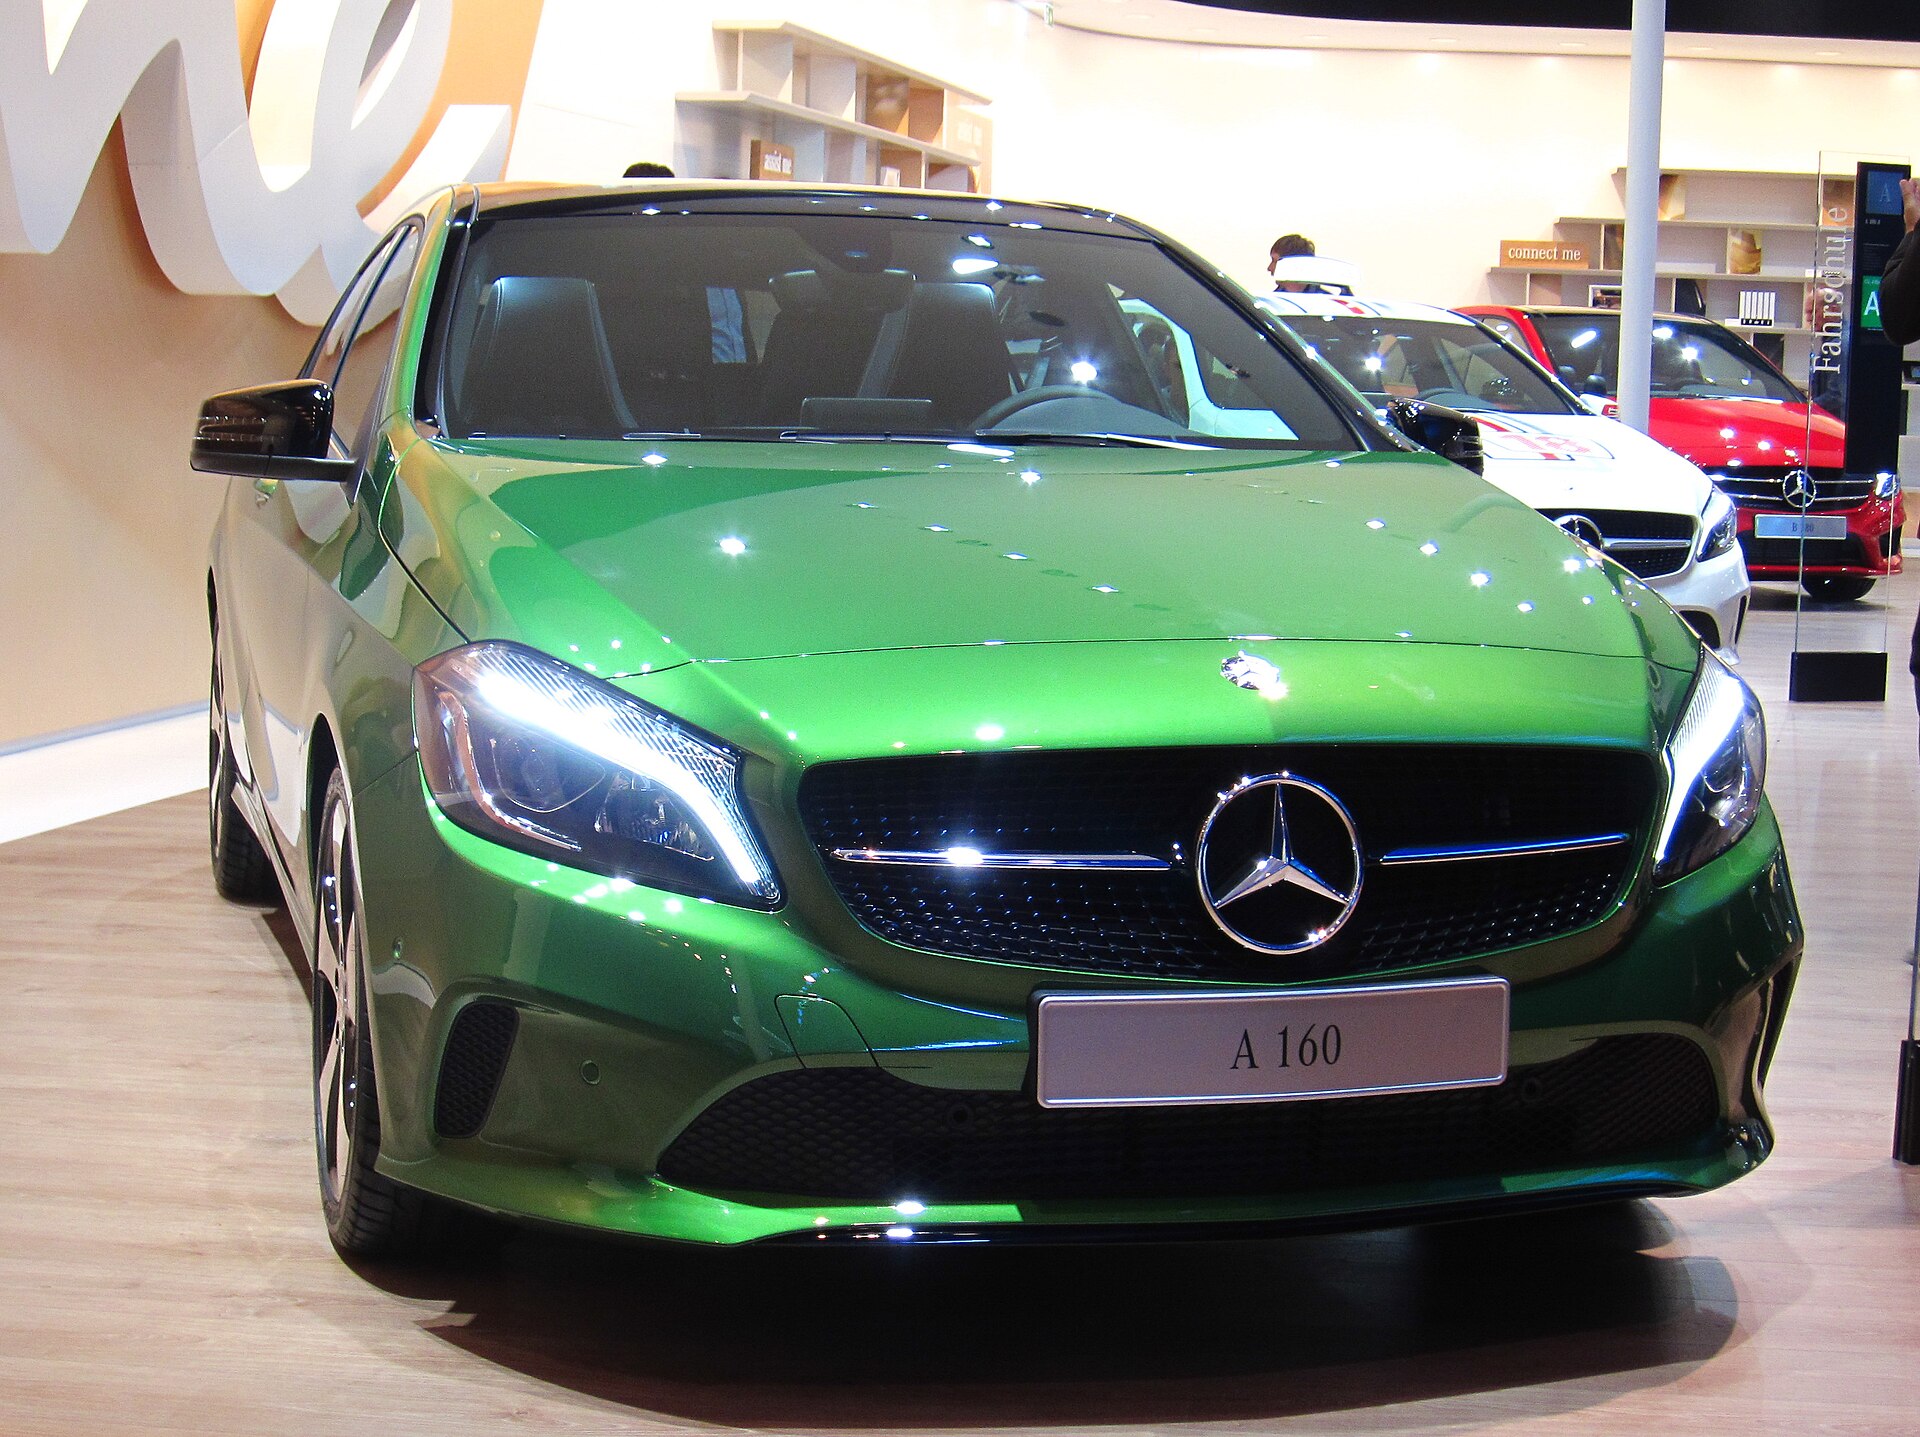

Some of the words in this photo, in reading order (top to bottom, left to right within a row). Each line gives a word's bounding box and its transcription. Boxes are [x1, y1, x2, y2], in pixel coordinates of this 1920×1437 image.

[1508, 246, 1558, 260] connect
[1562, 249, 1581, 260] me
[1230, 1028, 1259, 1070] A
[1278, 1024, 1342, 1068] 160
